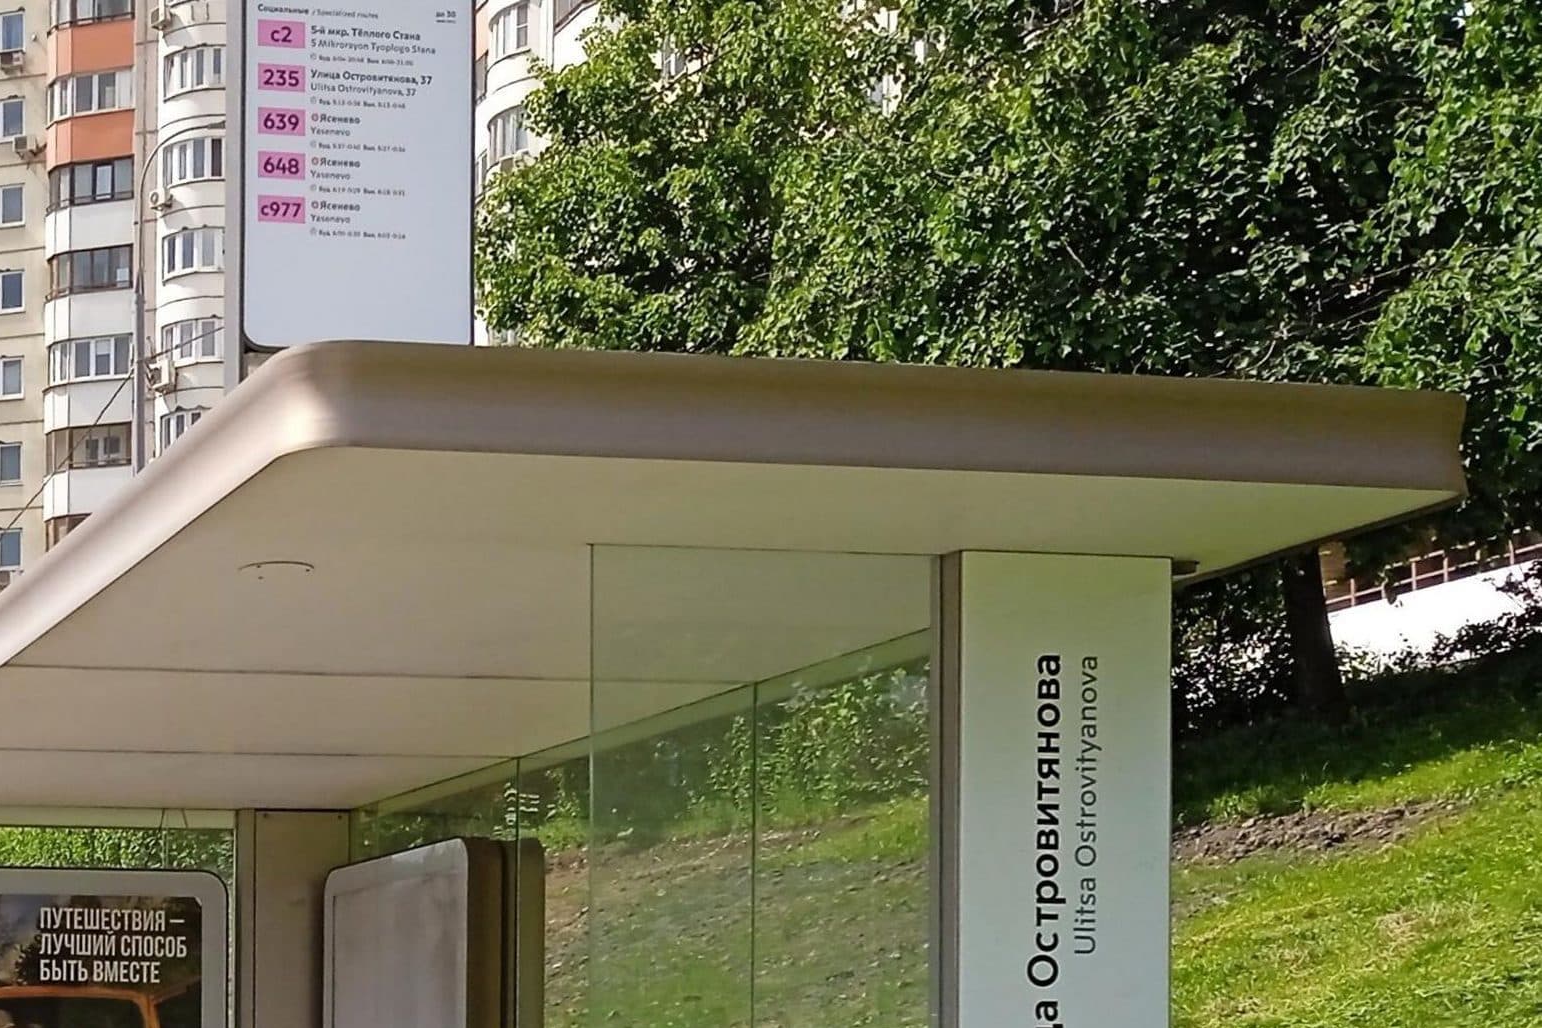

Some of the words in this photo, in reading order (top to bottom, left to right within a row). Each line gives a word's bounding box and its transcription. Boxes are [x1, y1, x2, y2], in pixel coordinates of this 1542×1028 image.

[352, 28, 391, 40] Тёплого
[393, 31, 421, 41] Стана
[263, 69, 299, 87] 235
[311, 69, 340, 80] Улица
[343, 71, 419, 85] Островитянова,
[420, 76, 433, 85] 37
[406, 88, 416, 96] 37
[263, 113, 299, 131] 639
[320, 113, 360, 124] Ясенево
[263, 157, 299, 175] 648
[320, 157, 360, 168] Ясенево
[320, 201, 360, 211] Ясенево
[1074, 655, 1104, 869] Ostrovityanova
[1026, 653, 1066, 989] Островитянова
[39, 906, 166, 932] ПУТЕШЕСТВИЯ
[1074, 877, 1097, 955] Ulitsa
[39, 930, 116, 957] ЛУЧШИЙ
[120, 935, 188, 958] СПОСОБ
[39, 959, 89, 982] БЫТЬ
[92, 960, 161, 984] ВМЕСТЕ
